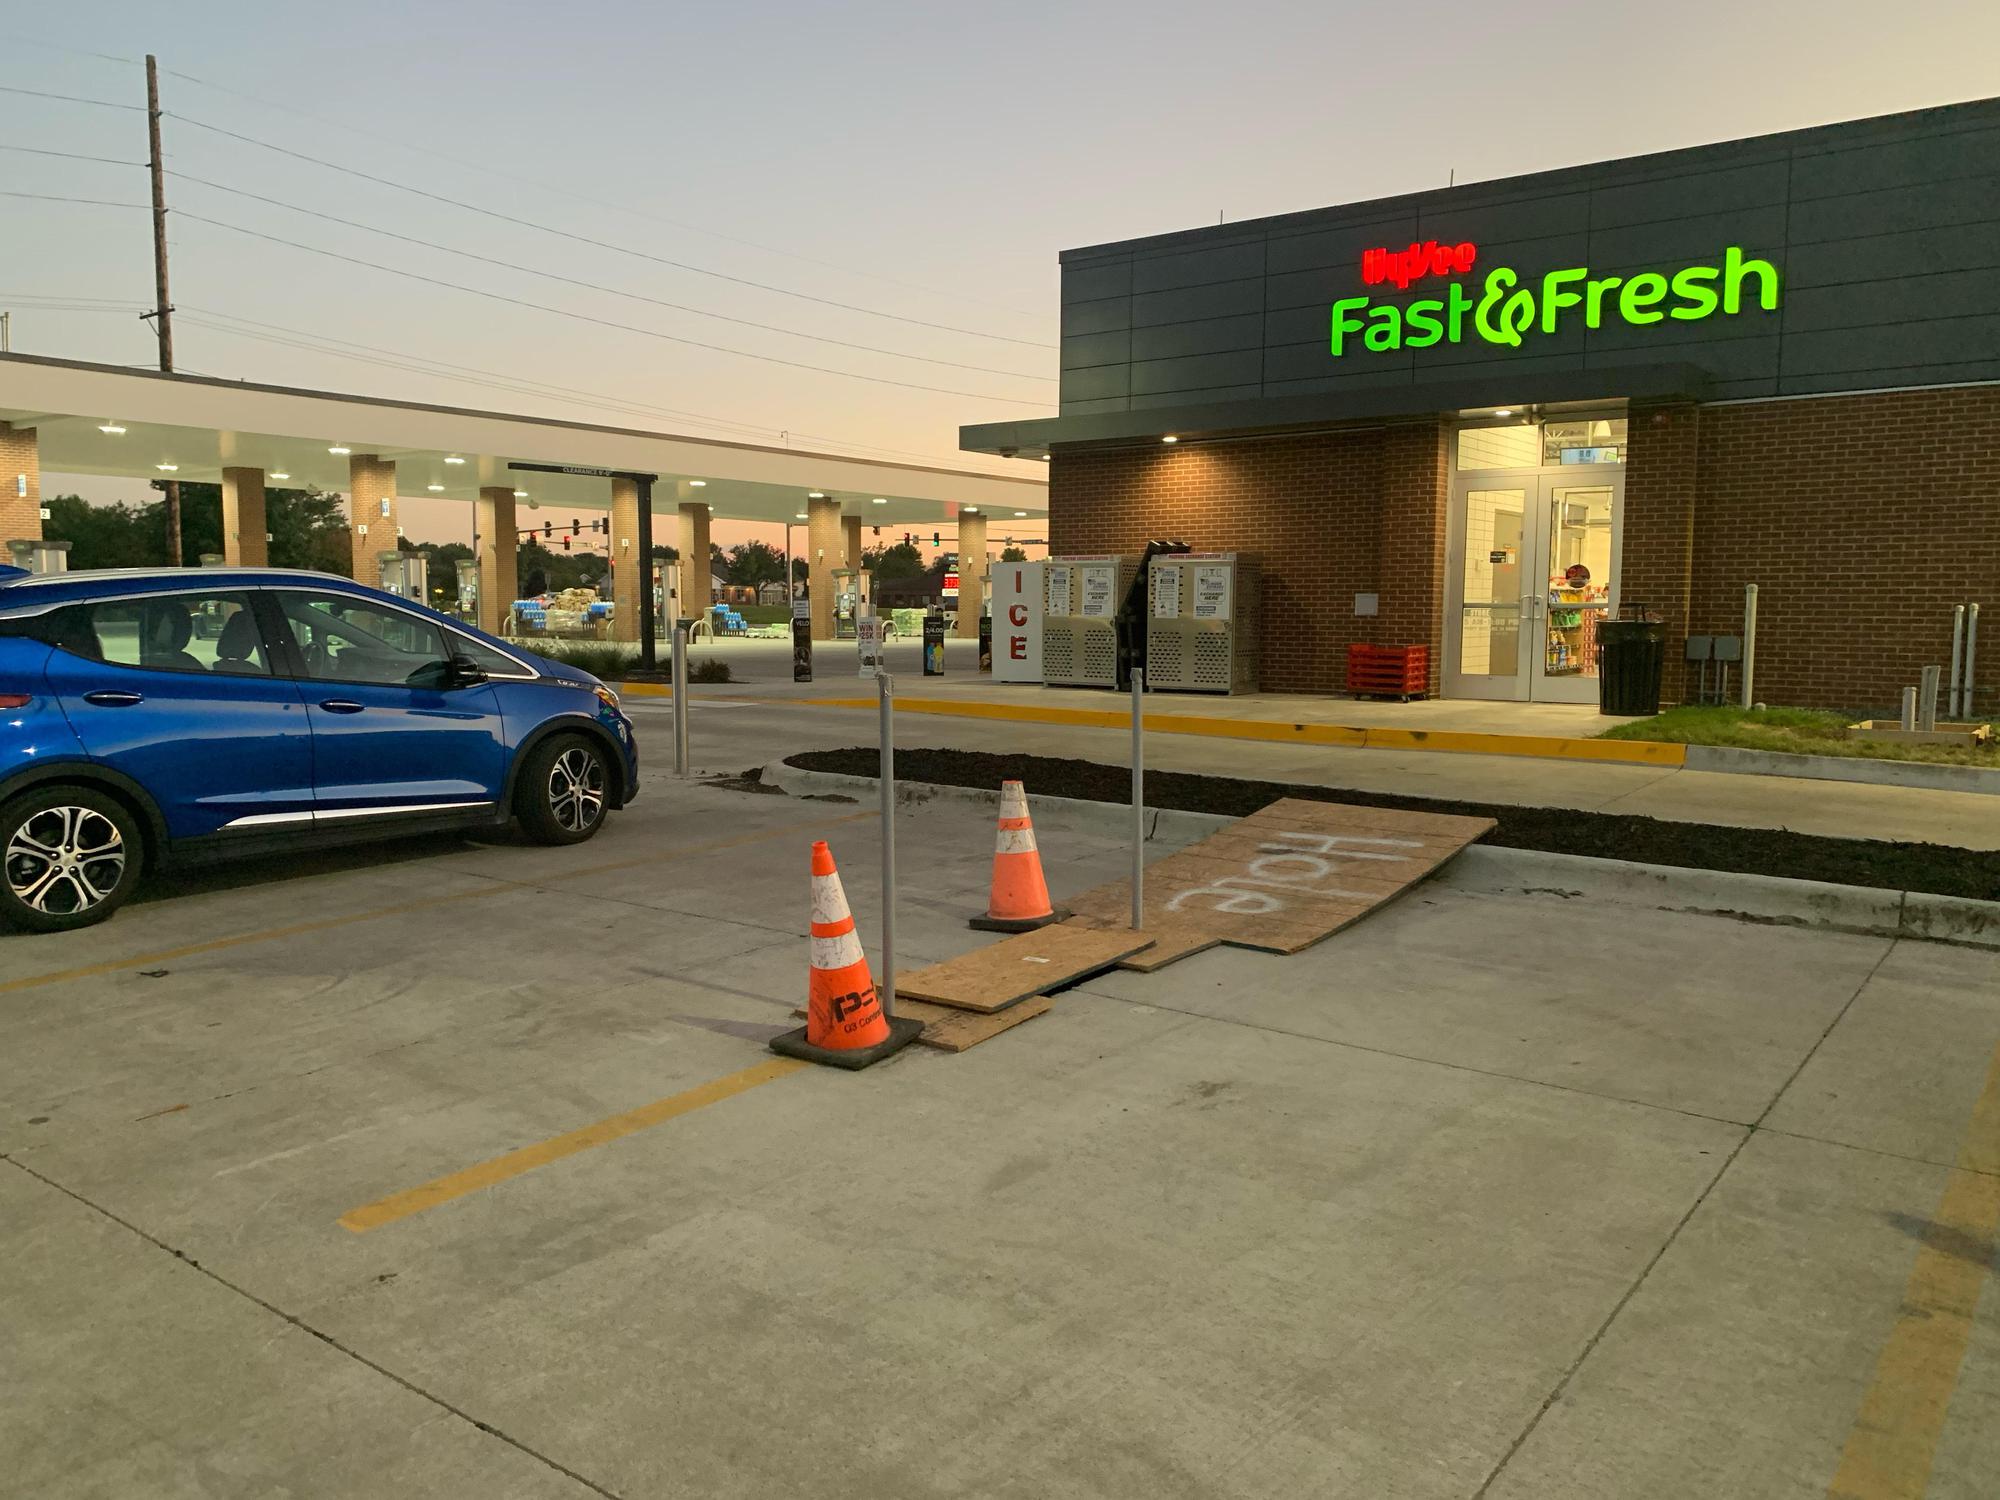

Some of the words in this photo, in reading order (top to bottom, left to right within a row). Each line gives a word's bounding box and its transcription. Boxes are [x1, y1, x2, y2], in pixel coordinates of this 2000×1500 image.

[1331, 283, 1473, 356] Fast
[1475, 267, 1535, 347] &
[1542, 246, 1777, 333] Fresh
[563, 467, 597, 475] CLEARANCE
[859, 624, 874, 632] WIN
[1009, 571, 1028, 660] ICE
